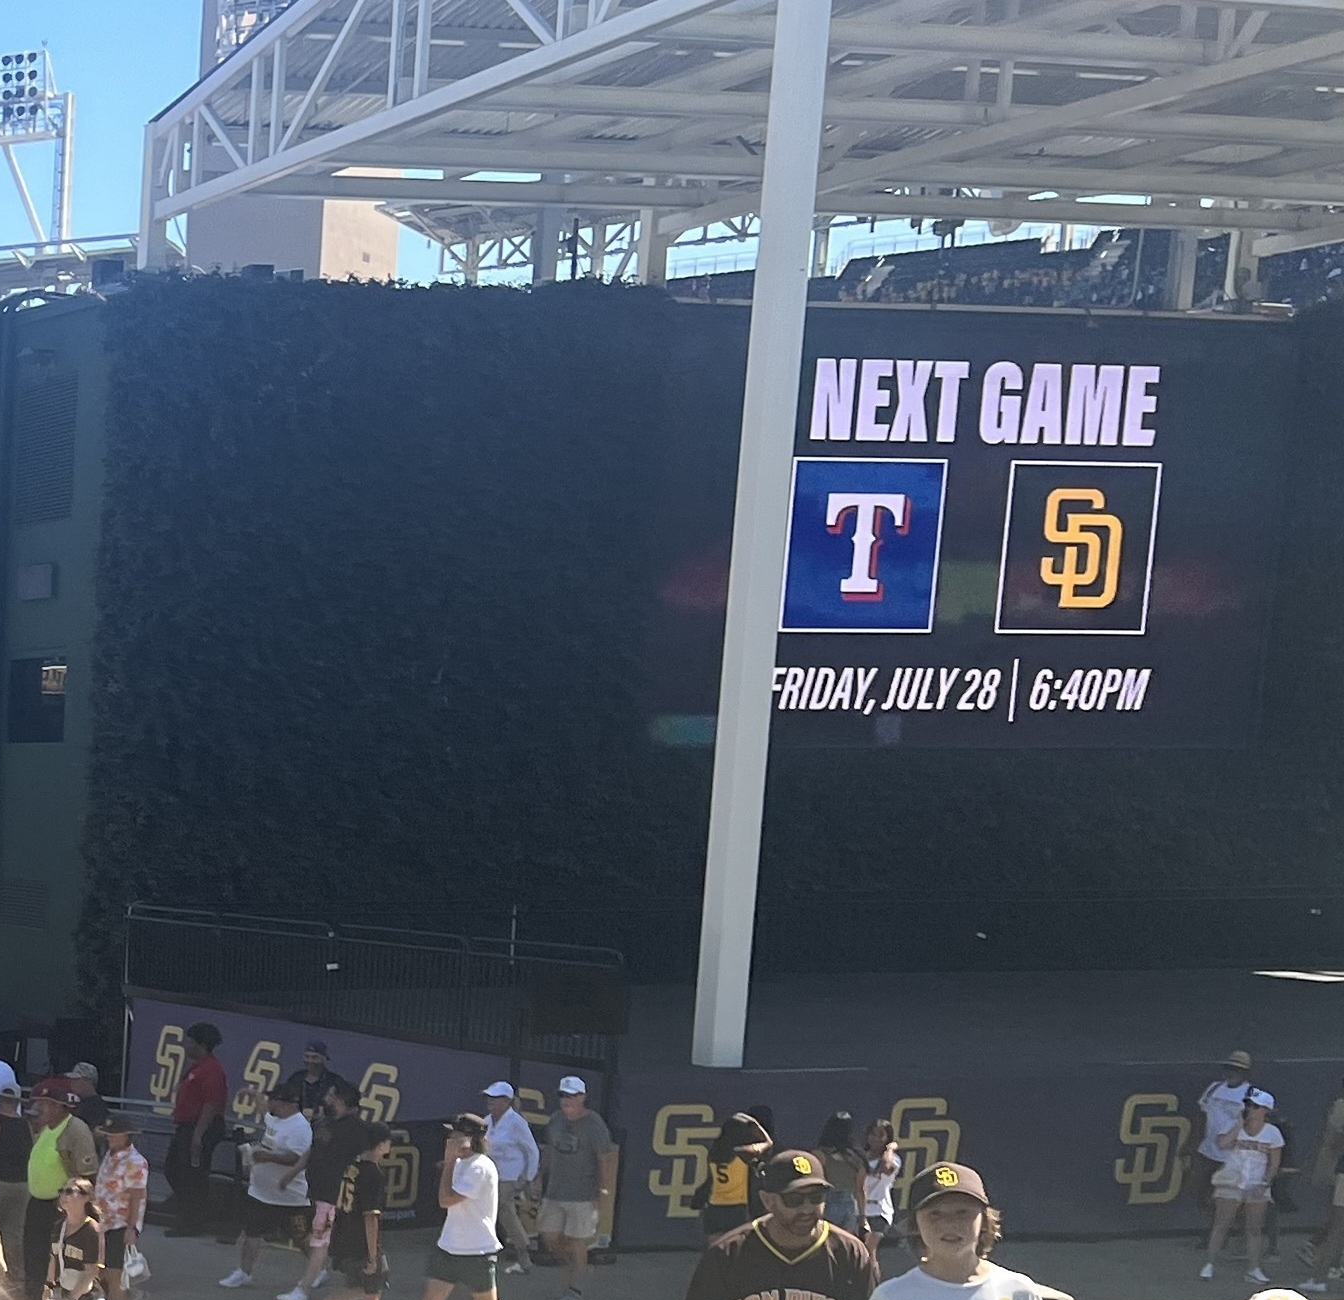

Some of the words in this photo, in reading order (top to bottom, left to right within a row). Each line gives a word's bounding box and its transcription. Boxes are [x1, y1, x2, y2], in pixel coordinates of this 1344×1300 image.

[809, 357, 970, 443] NEXT
[978, 361, 1161, 447] GAME
[825, 493, 910, 601] T
[1040, 487, 1122, 609] SD
[771, 666, 879, 716] FRIDAY,
[881, 667, 959, 711] JULY
[957, 668, 998, 712] 28
[1028, 668, 1152, 712] 6:40PM
[792, 1156, 812, 1175] SD
[935, 1166, 959, 1187] SD
[1115, 1093, 1192, 1205] SD
